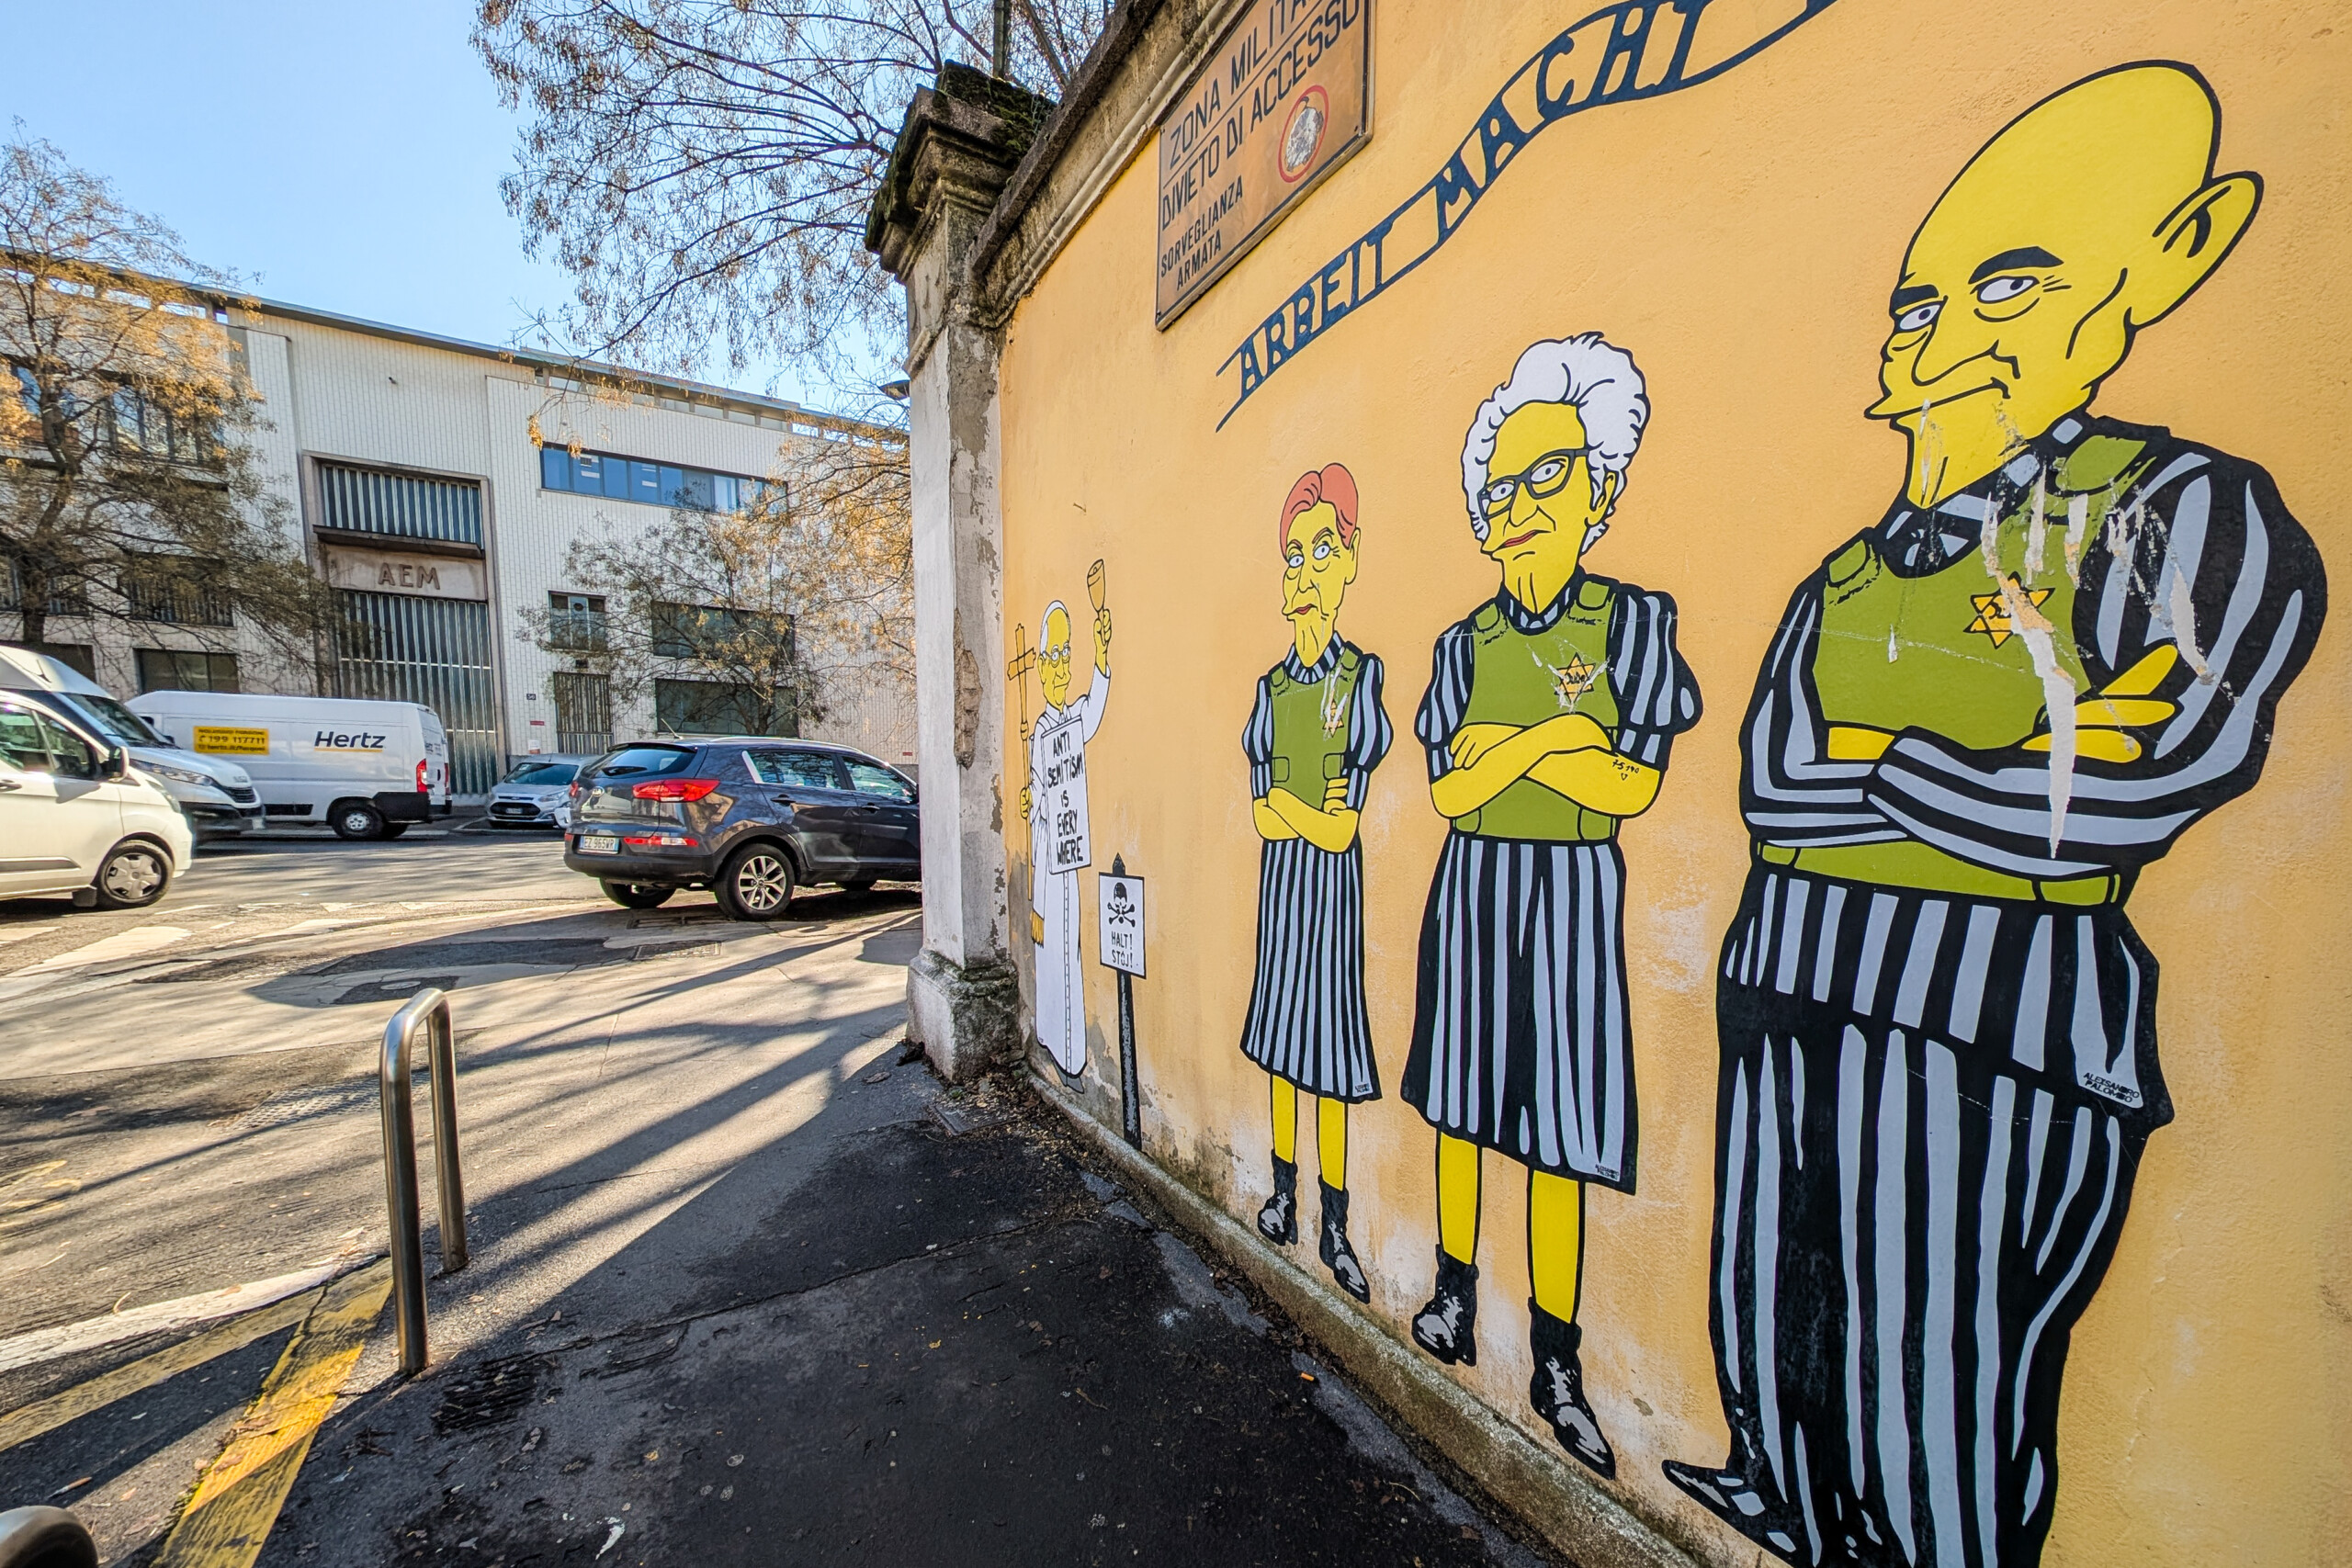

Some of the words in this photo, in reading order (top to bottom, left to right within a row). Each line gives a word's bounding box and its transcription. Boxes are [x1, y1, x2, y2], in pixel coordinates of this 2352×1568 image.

[1170, 78, 1221, 170] ZONA
[1162, 135, 1220, 231] DIVIETO
[1227, 106, 1243, 159] DI
[1161, 175, 1243, 277] SORVEGLIANZA
[1177, 229, 1221, 291] ARMATA
[1239, 219, 1395, 402] ARBEIT
[378, 562, 441, 591] AEM
[314, 731, 387, 749] Hertz
[1053, 730, 1071, 759] ANTI
[1057, 808, 1078, 838] EVERY
[1057, 835, 1084, 866] WHERE
[1111, 931, 1133, 951] HALT!
